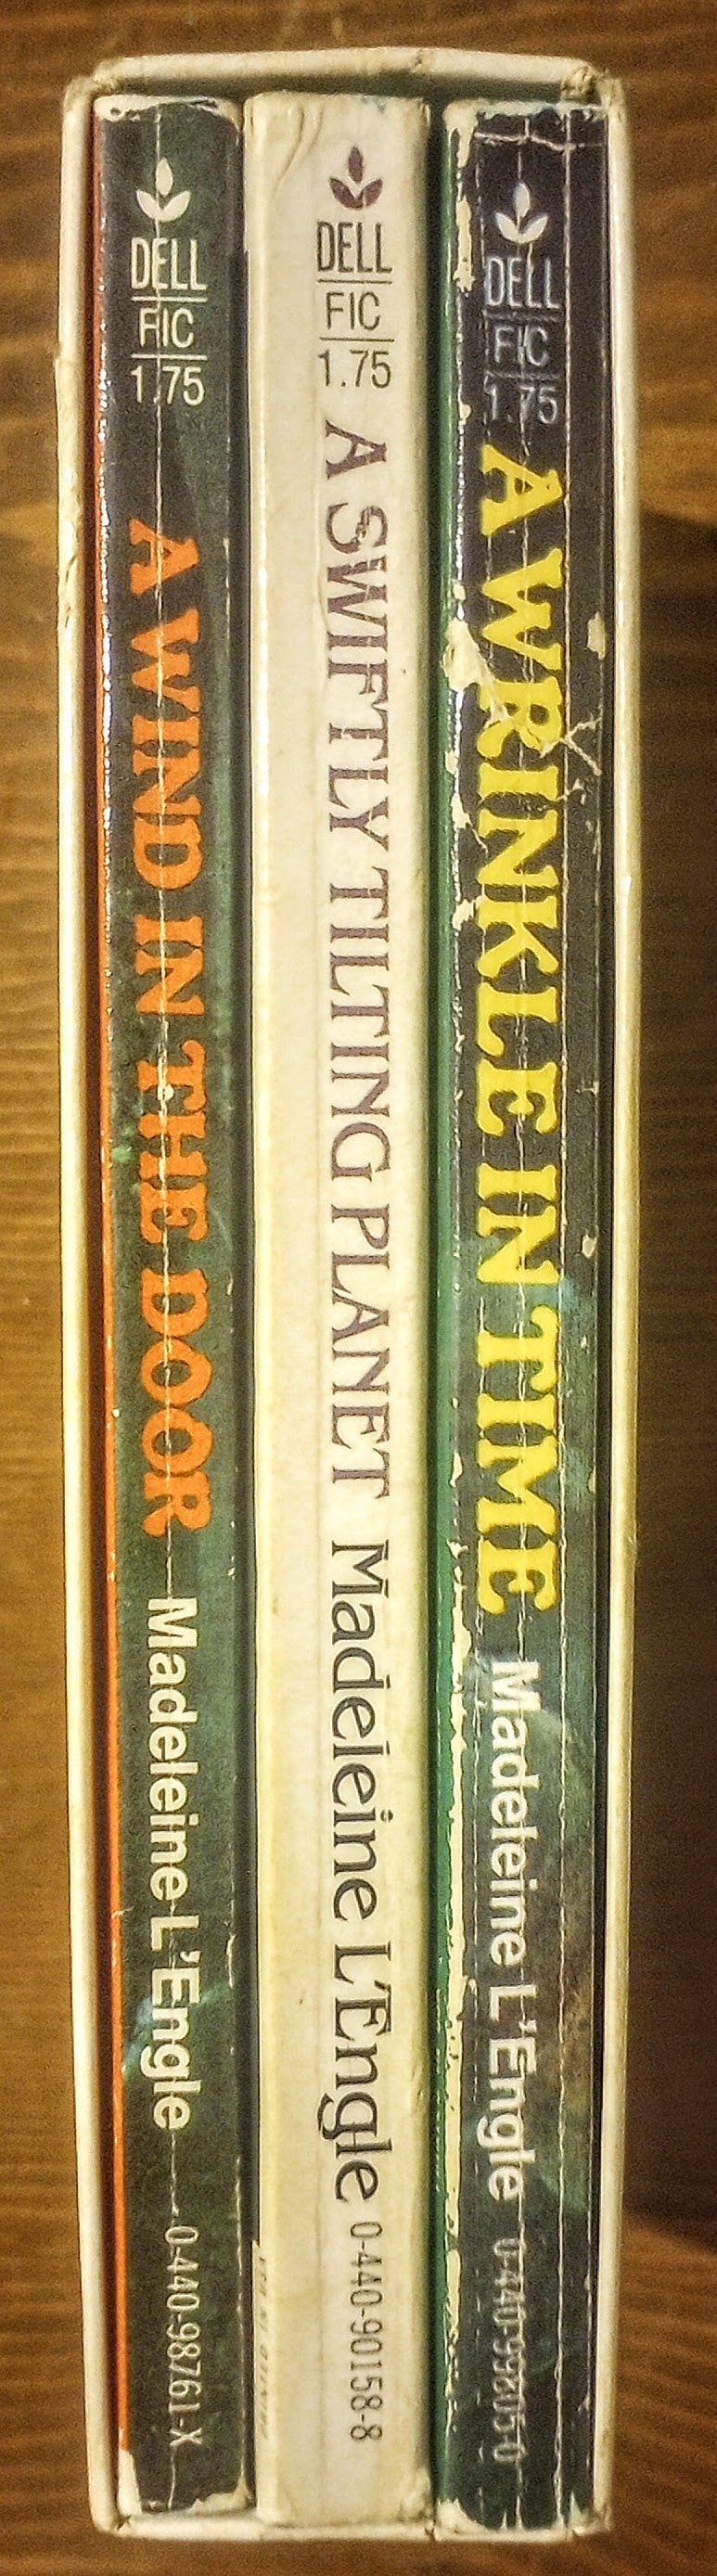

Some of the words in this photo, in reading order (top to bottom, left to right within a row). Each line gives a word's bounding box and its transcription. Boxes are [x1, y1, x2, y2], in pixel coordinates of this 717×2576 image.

[131, 237, 208, 290] DELL
[139, 307, 195, 348] FIC
[317, 222, 392, 275] DELL
[326, 292, 380, 331] FIC
[484, 257, 560, 309] DELL
[494, 326, 549, 367] FIC
[130, 364, 206, 406] 1.75
[318, 351, 392, 390] 1.75
[325, 419, 388, 480] A
[488, 383, 557, 425] 1.75
[130, 518, 199, 595] A
[481, 443, 563, 535] A
[130, 609, 202, 890] WIND
[325, 502, 390, 852] SWIFTLY
[477, 549, 563, 1138] WRINKLE
[136, 915, 204, 1015] IN
[328, 866, 391, 1181] TILTING
[138, 1039, 208, 1243] THE
[477, 1164, 560, 1285] IN
[141, 1268, 213, 1538] DOOR
[330, 1204, 391, 1499] PLANET
[477, 1306, 561, 1615] TIME
[146, 1597, 198, 1904] Madeleine
[330, 1540, 393, 1922] Madeleine
[490, 1660, 541, 1966] Madeleine
[141, 1916, 201, 2130] L'Engle
[316, 1942, 393, 2203] L'Engle
[477, 1984, 537, 2202] L'Engle
[164, 2224, 202, 2449] 0-440-98761-X
[349, 2221, 384, 2442] 0-440-90158-8
